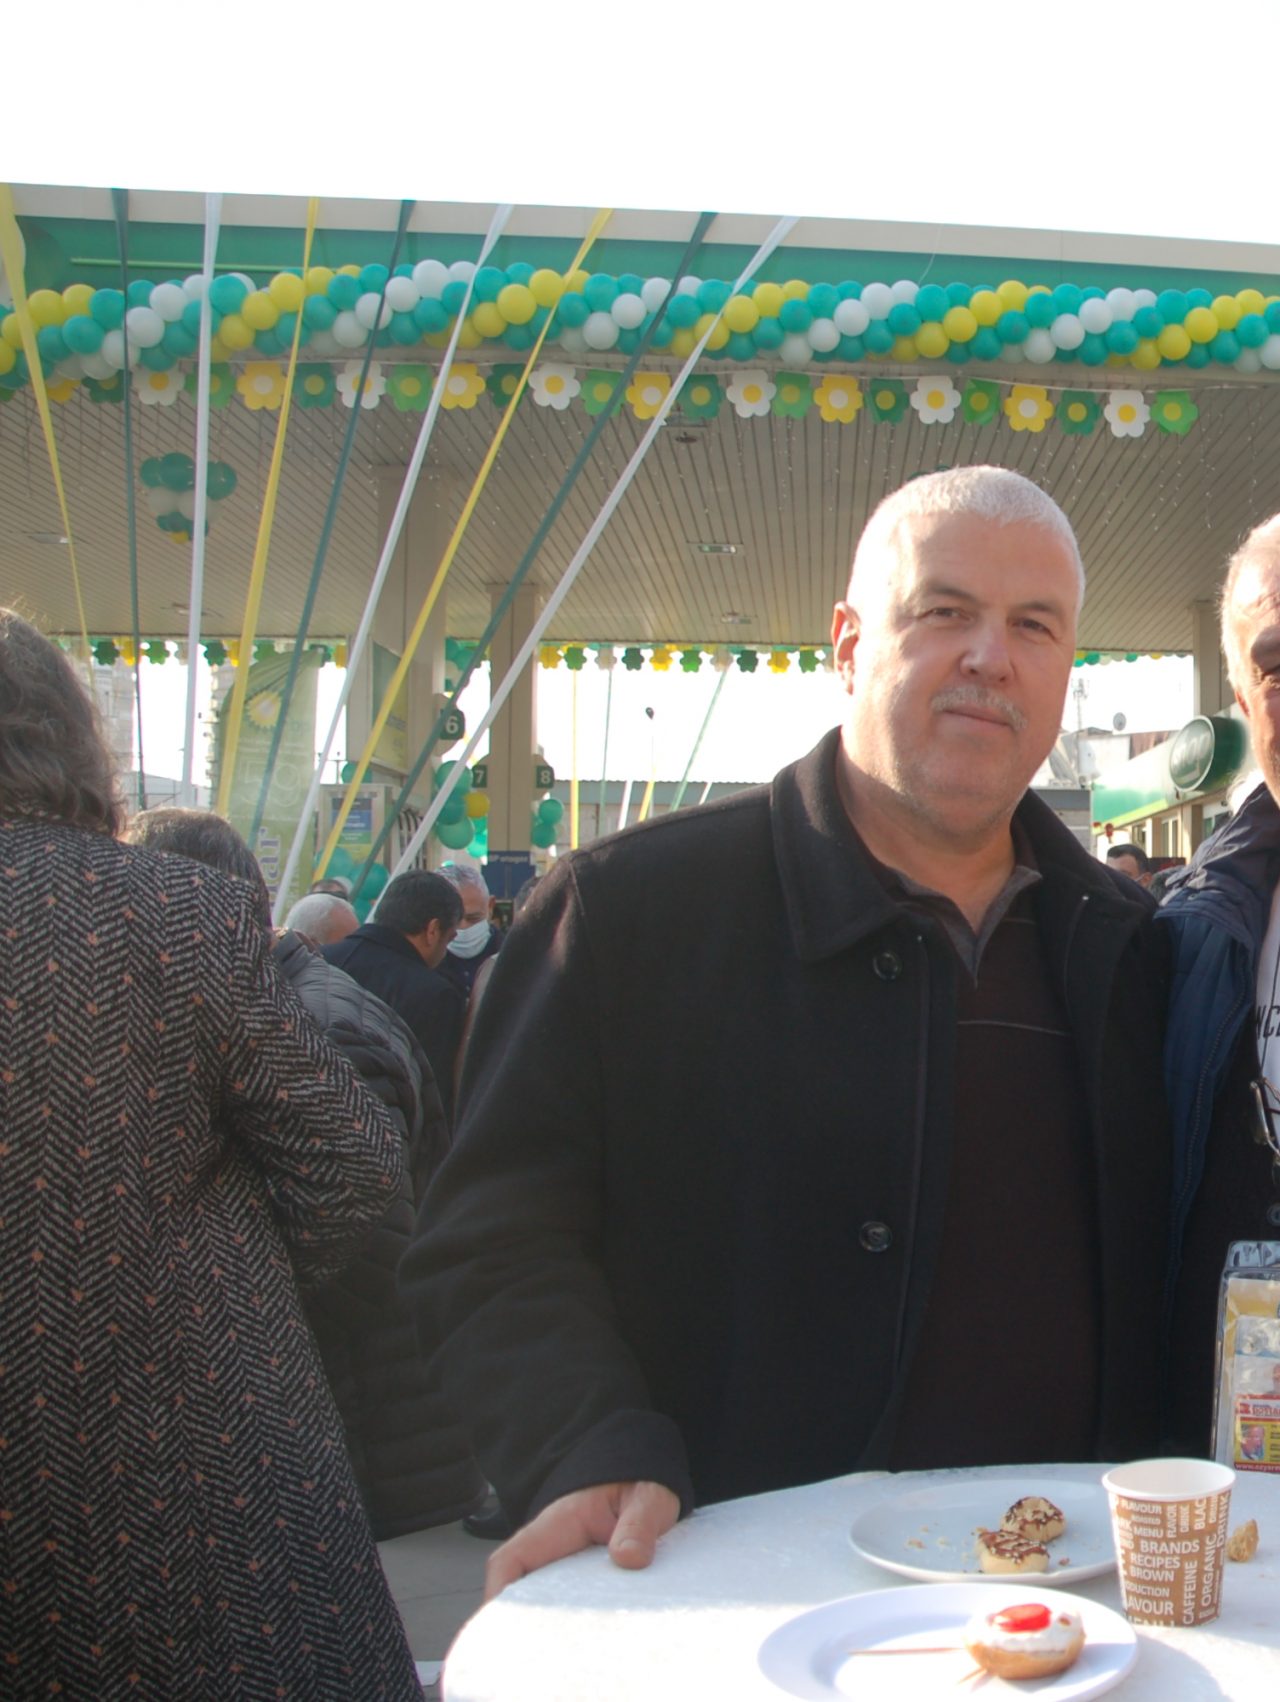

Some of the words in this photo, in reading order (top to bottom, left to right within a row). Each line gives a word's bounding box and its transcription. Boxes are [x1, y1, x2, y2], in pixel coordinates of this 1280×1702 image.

[445, 715, 459, 734] 6
[474, 769, 485, 784] 7
[540, 769, 551, 784] 8
[1133, 1526, 1164, 1538] MENU
[1140, 1539, 1200, 1555] BRANDS
[1130, 1552, 1181, 1569] RECIPES
[1130, 1565, 1175, 1582] BROWN
[1201, 1533, 1217, 1607] ORGANIC
[1183, 1560, 1198, 1625] CAFFEINE
